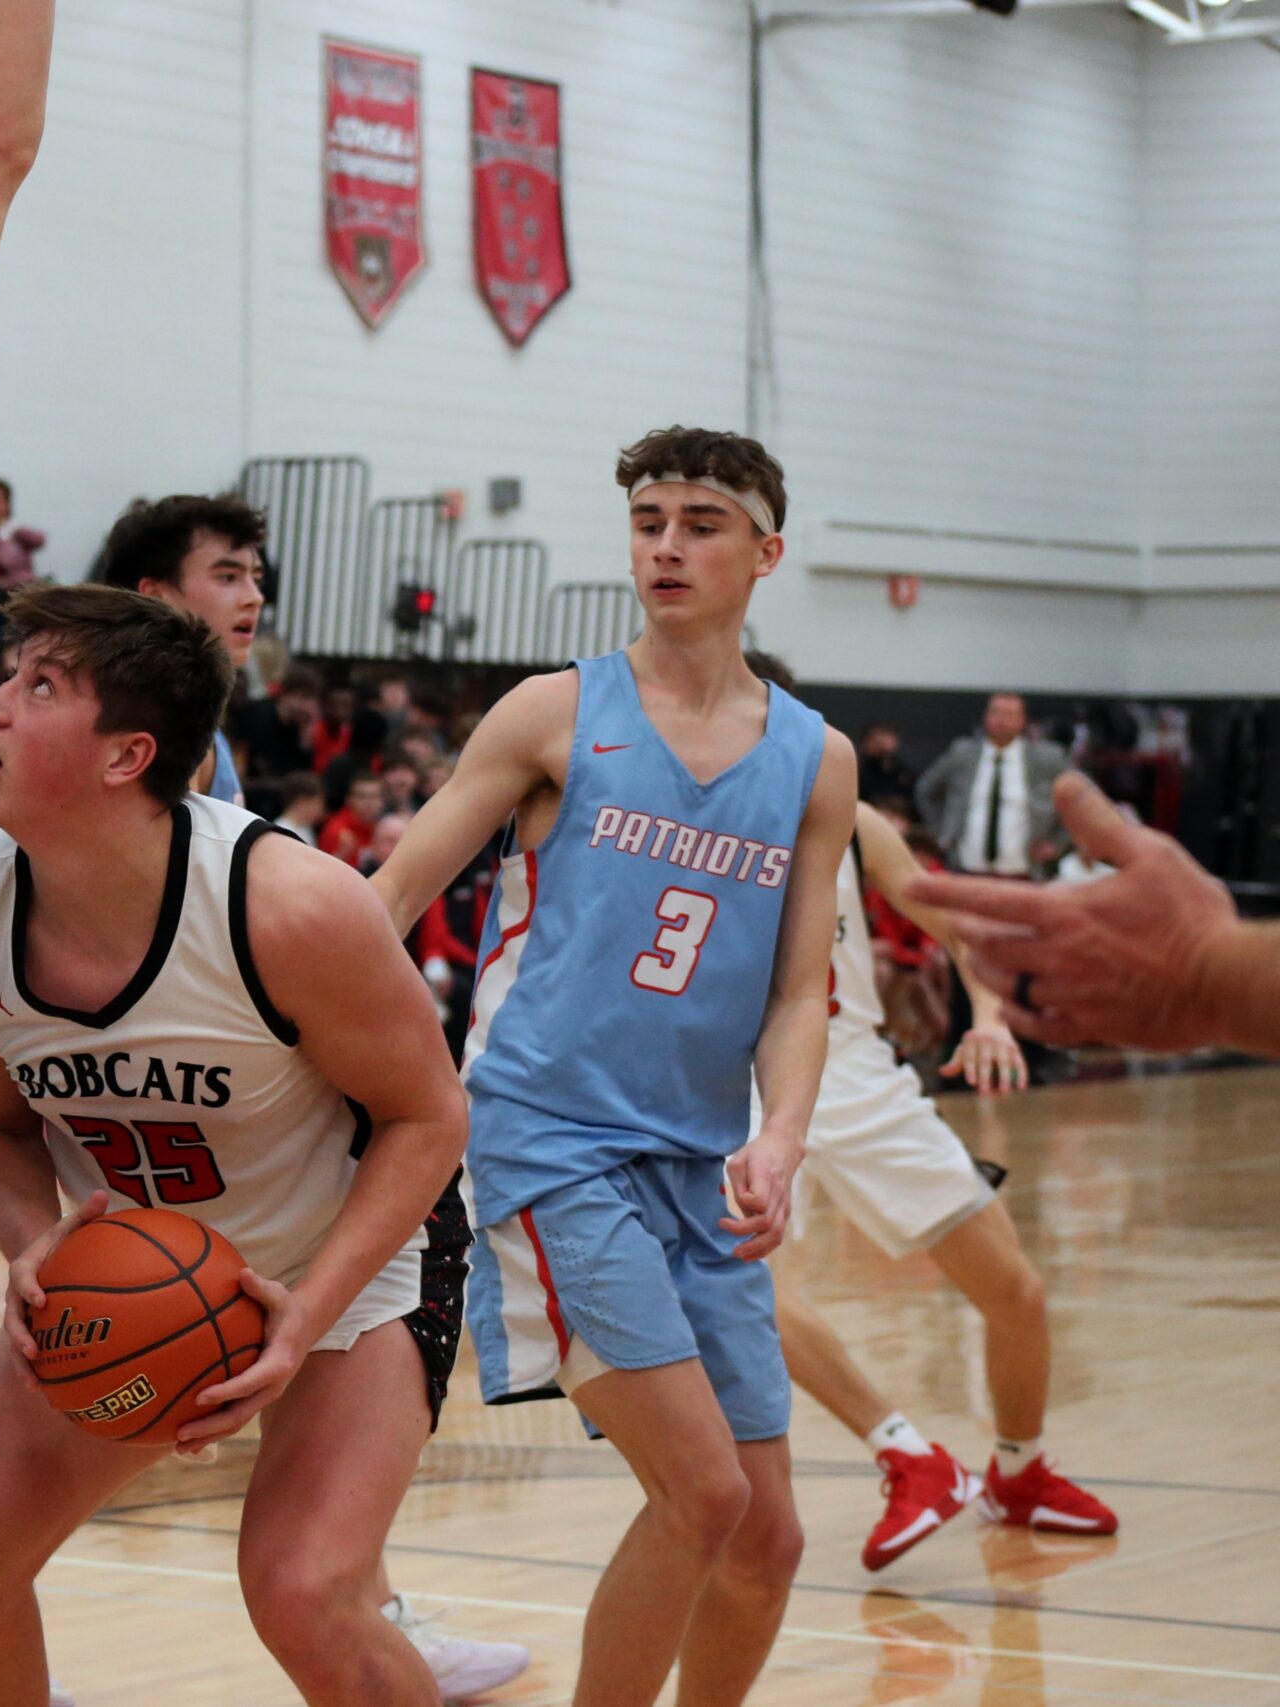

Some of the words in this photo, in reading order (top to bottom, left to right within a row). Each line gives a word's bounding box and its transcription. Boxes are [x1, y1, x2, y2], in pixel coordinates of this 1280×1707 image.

[588, 806, 792, 889] PATRIOTS
[630, 885, 718, 997] 3
[16, 1052, 231, 1108] BOBCATS
[59, 1113, 226, 1209] 25
[28, 1307, 113, 1353] aden
